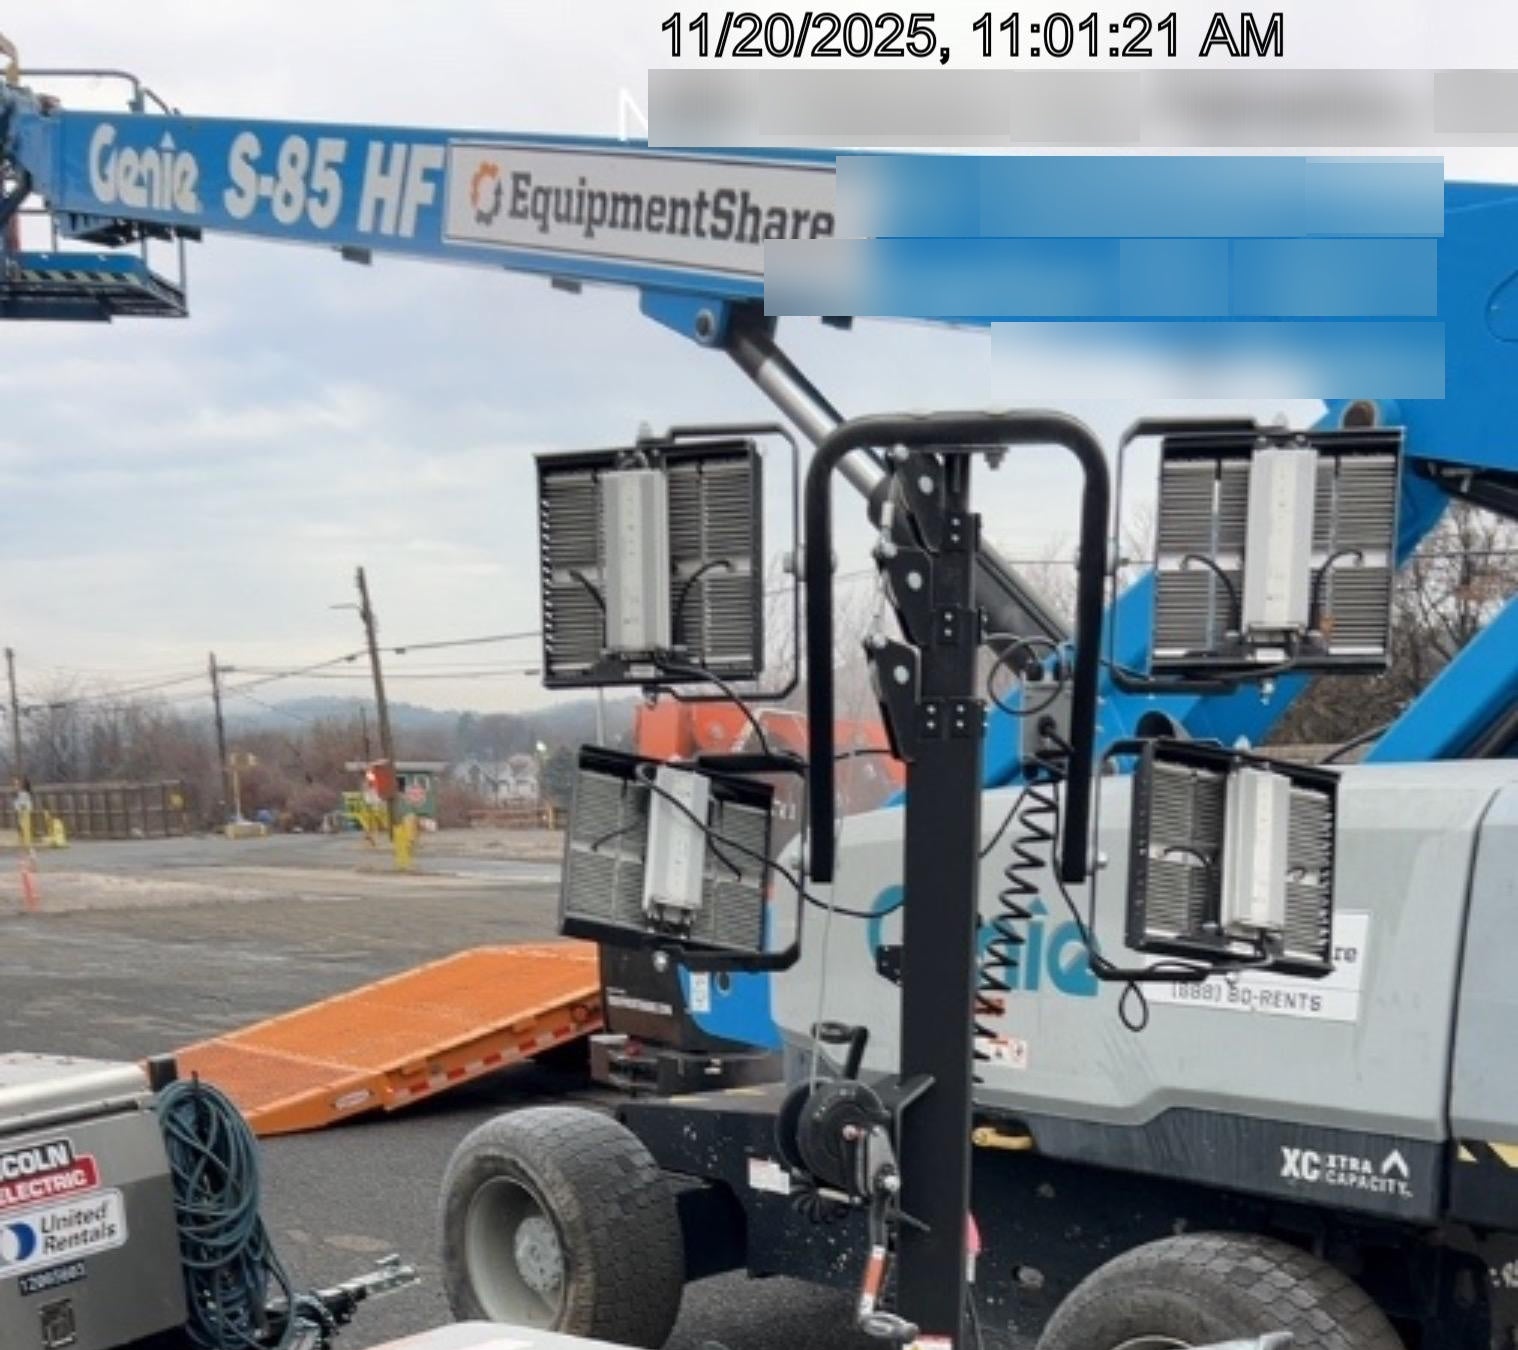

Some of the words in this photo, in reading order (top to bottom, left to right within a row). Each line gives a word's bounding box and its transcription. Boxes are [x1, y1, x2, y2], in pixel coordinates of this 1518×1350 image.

[89, 123, 200, 214] Genie
[224, 131, 347, 229] S-85
[357, 140, 445, 238] HF
[508, 172, 834, 244] EquipmentShare
[0, 1142, 70, 1179] COLN
[1281, 1146, 1320, 1181] XC
[41, 1203, 108, 1233] United
[44, 1221, 117, 1254] Rentals
